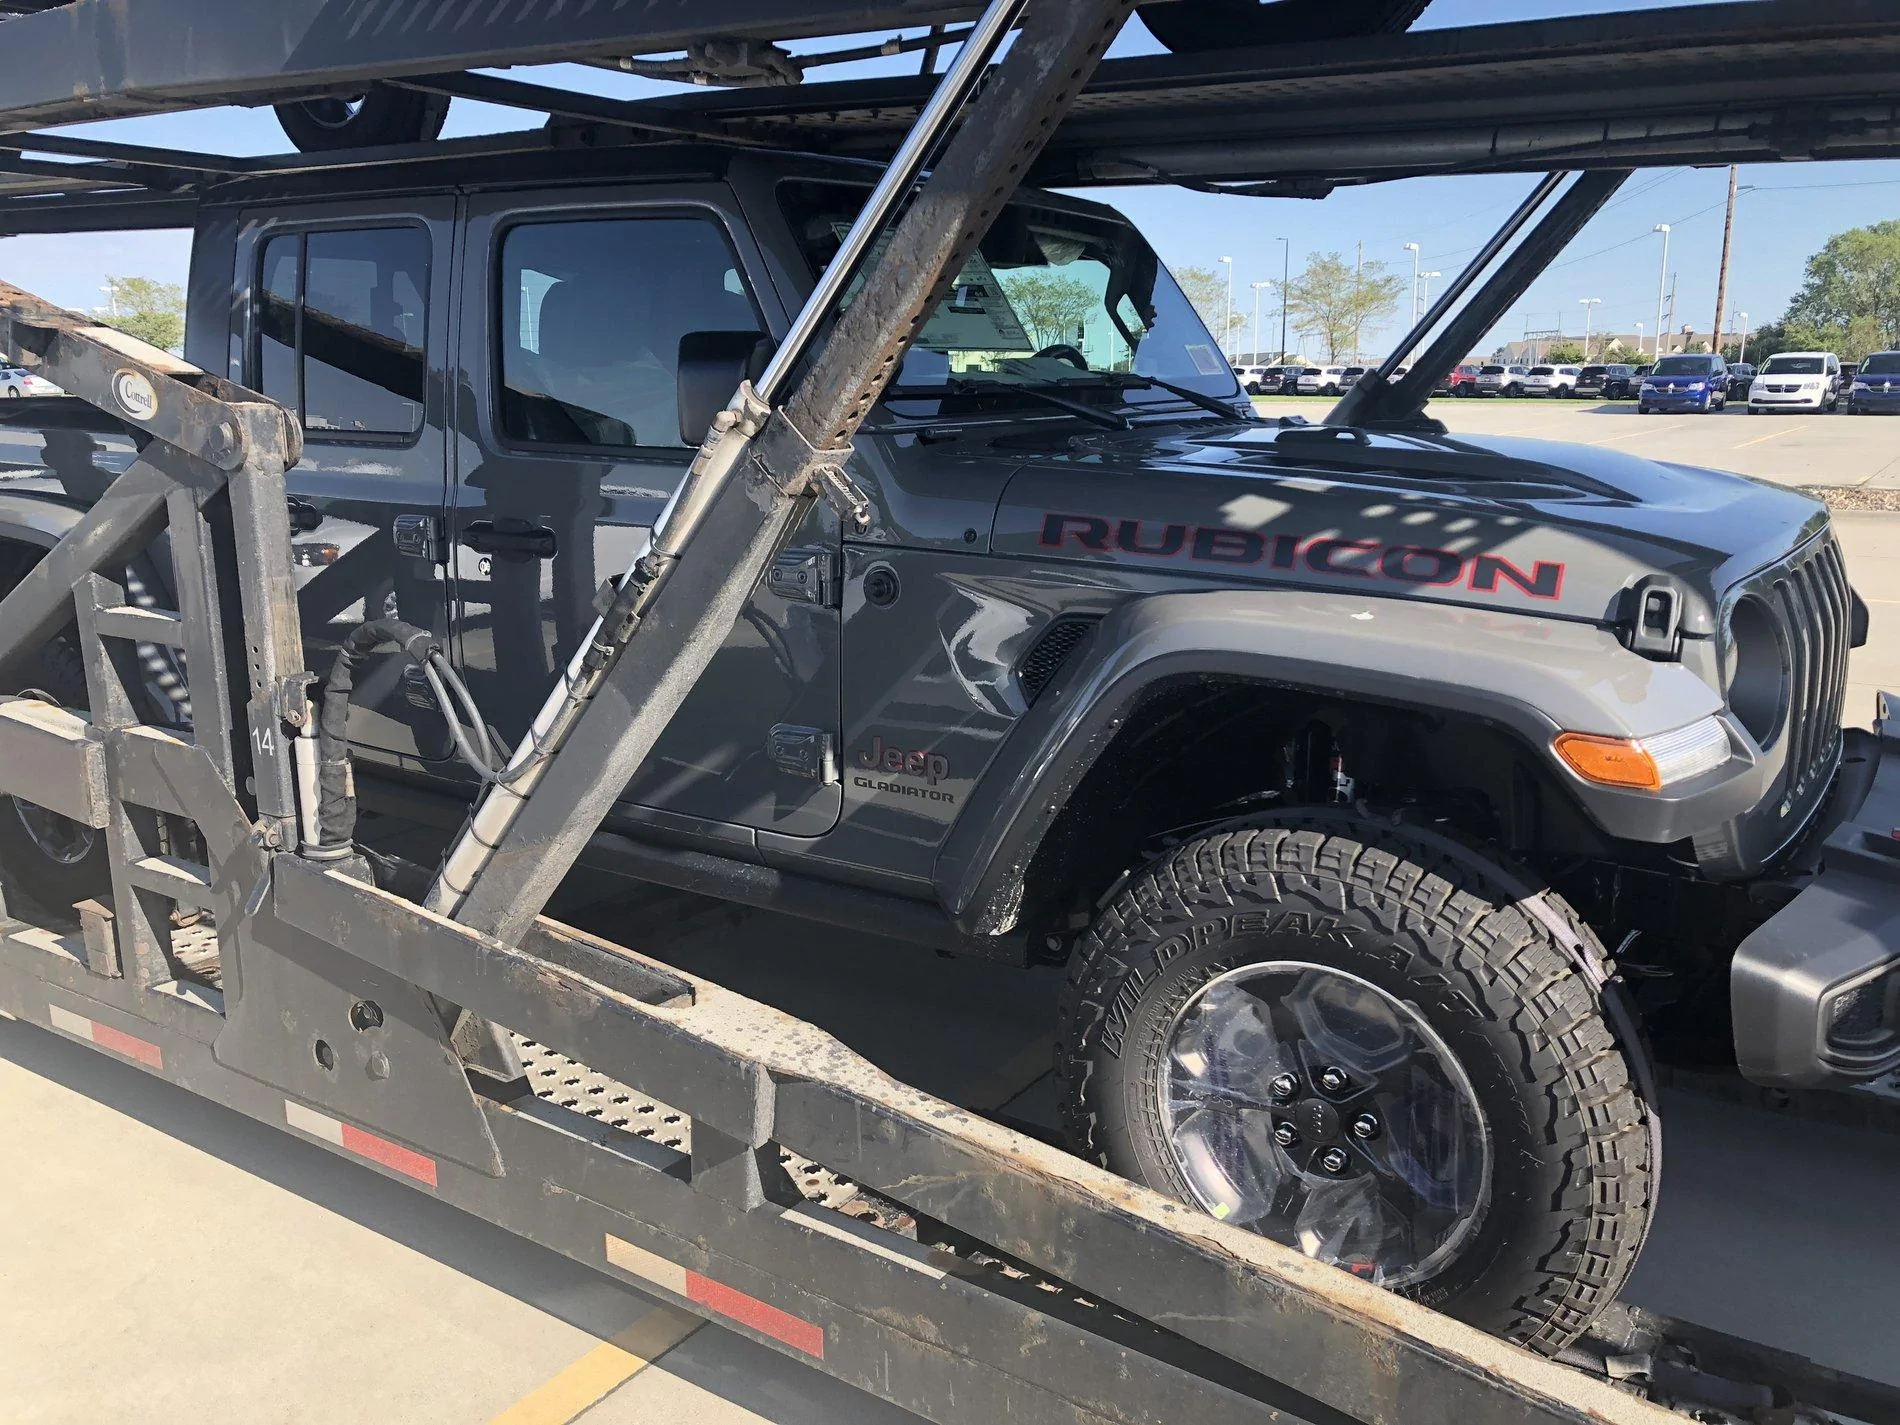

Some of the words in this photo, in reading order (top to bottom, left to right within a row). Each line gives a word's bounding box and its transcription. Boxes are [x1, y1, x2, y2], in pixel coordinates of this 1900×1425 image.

[125, 380, 153, 409] Cottrell
[1038, 512, 1566, 600] RUBICON
[252, 726, 275, 757] 14
[858, 736, 950, 786] Jeep
[854, 776, 955, 803] GLADIATOR
[1101, 909, 1367, 1059] WILDPEAK
